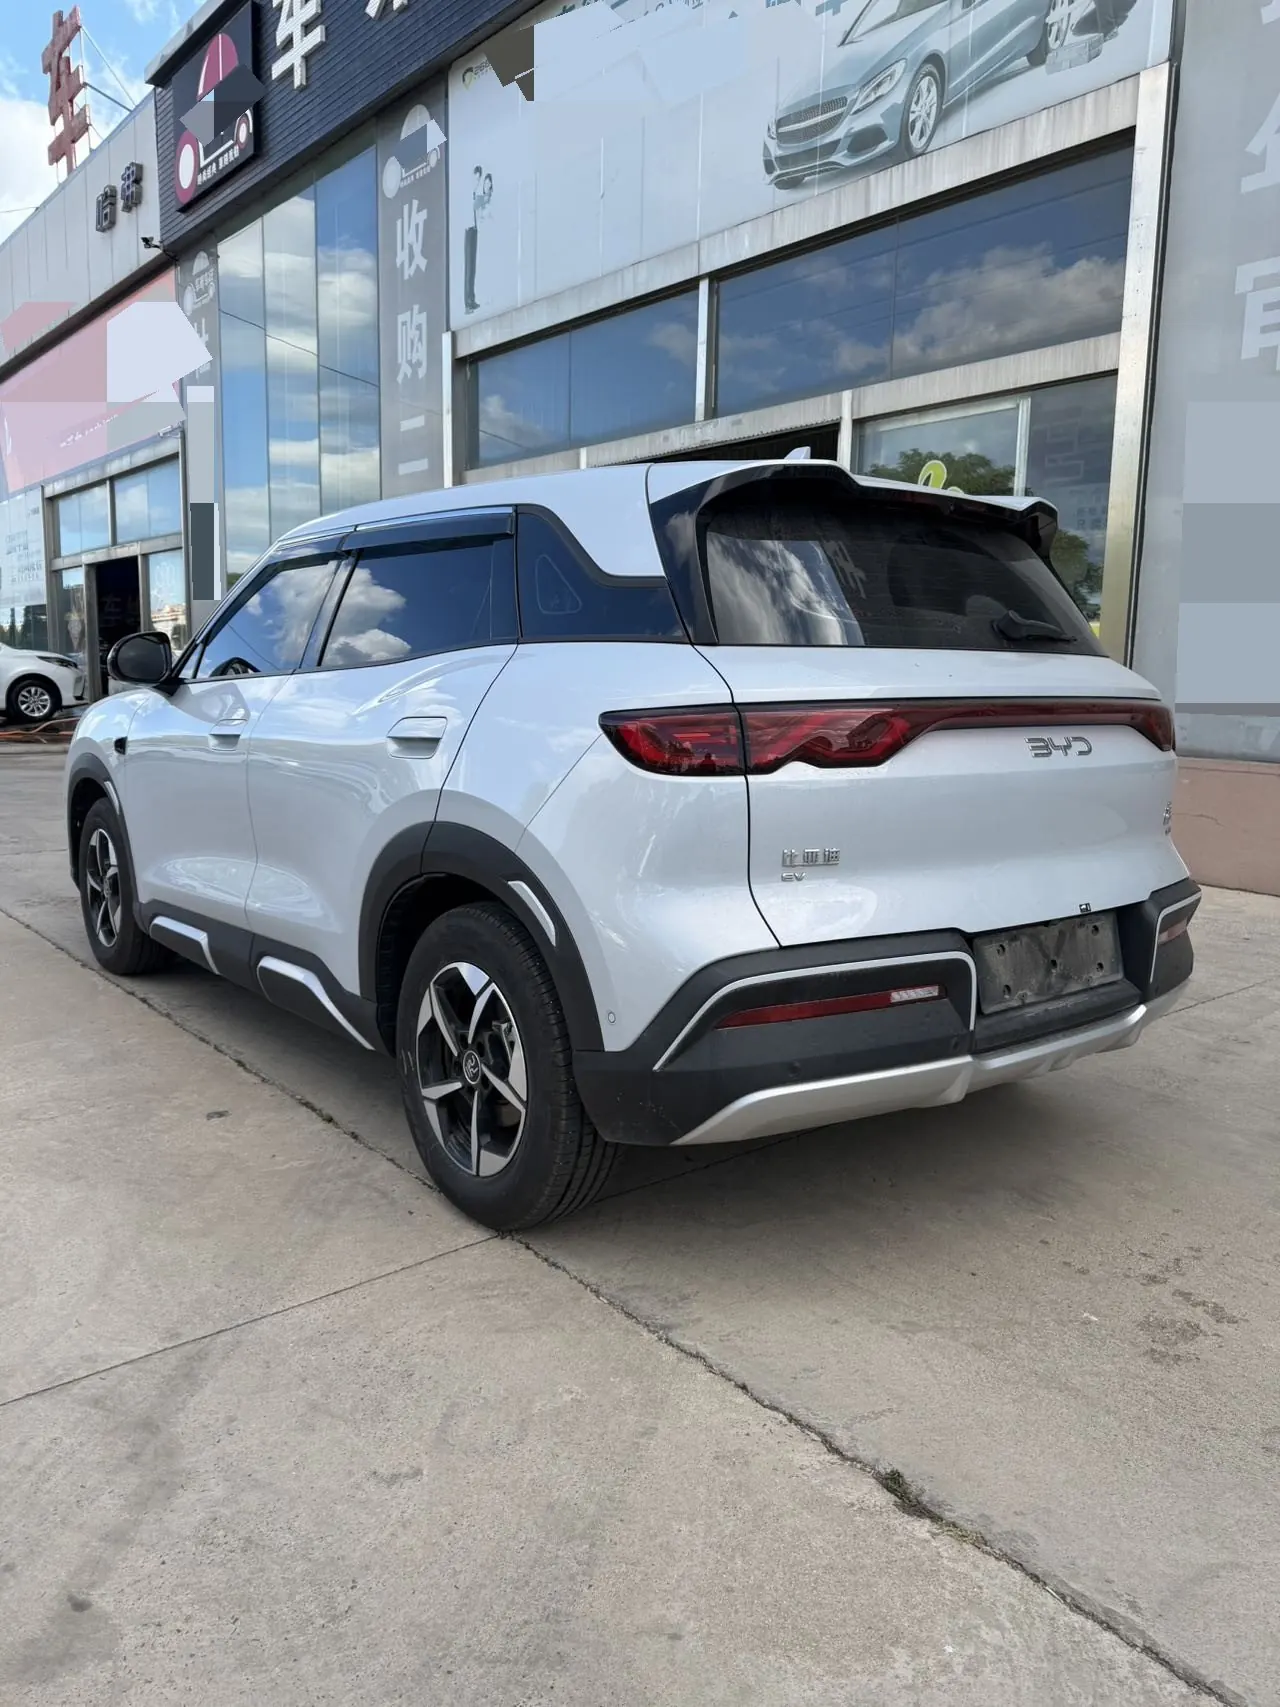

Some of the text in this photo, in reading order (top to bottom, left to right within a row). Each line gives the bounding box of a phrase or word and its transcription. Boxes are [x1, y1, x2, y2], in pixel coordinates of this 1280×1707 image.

[1025, 736, 1092, 758] BYD
[781, 848, 840, 868] 比亚迪
